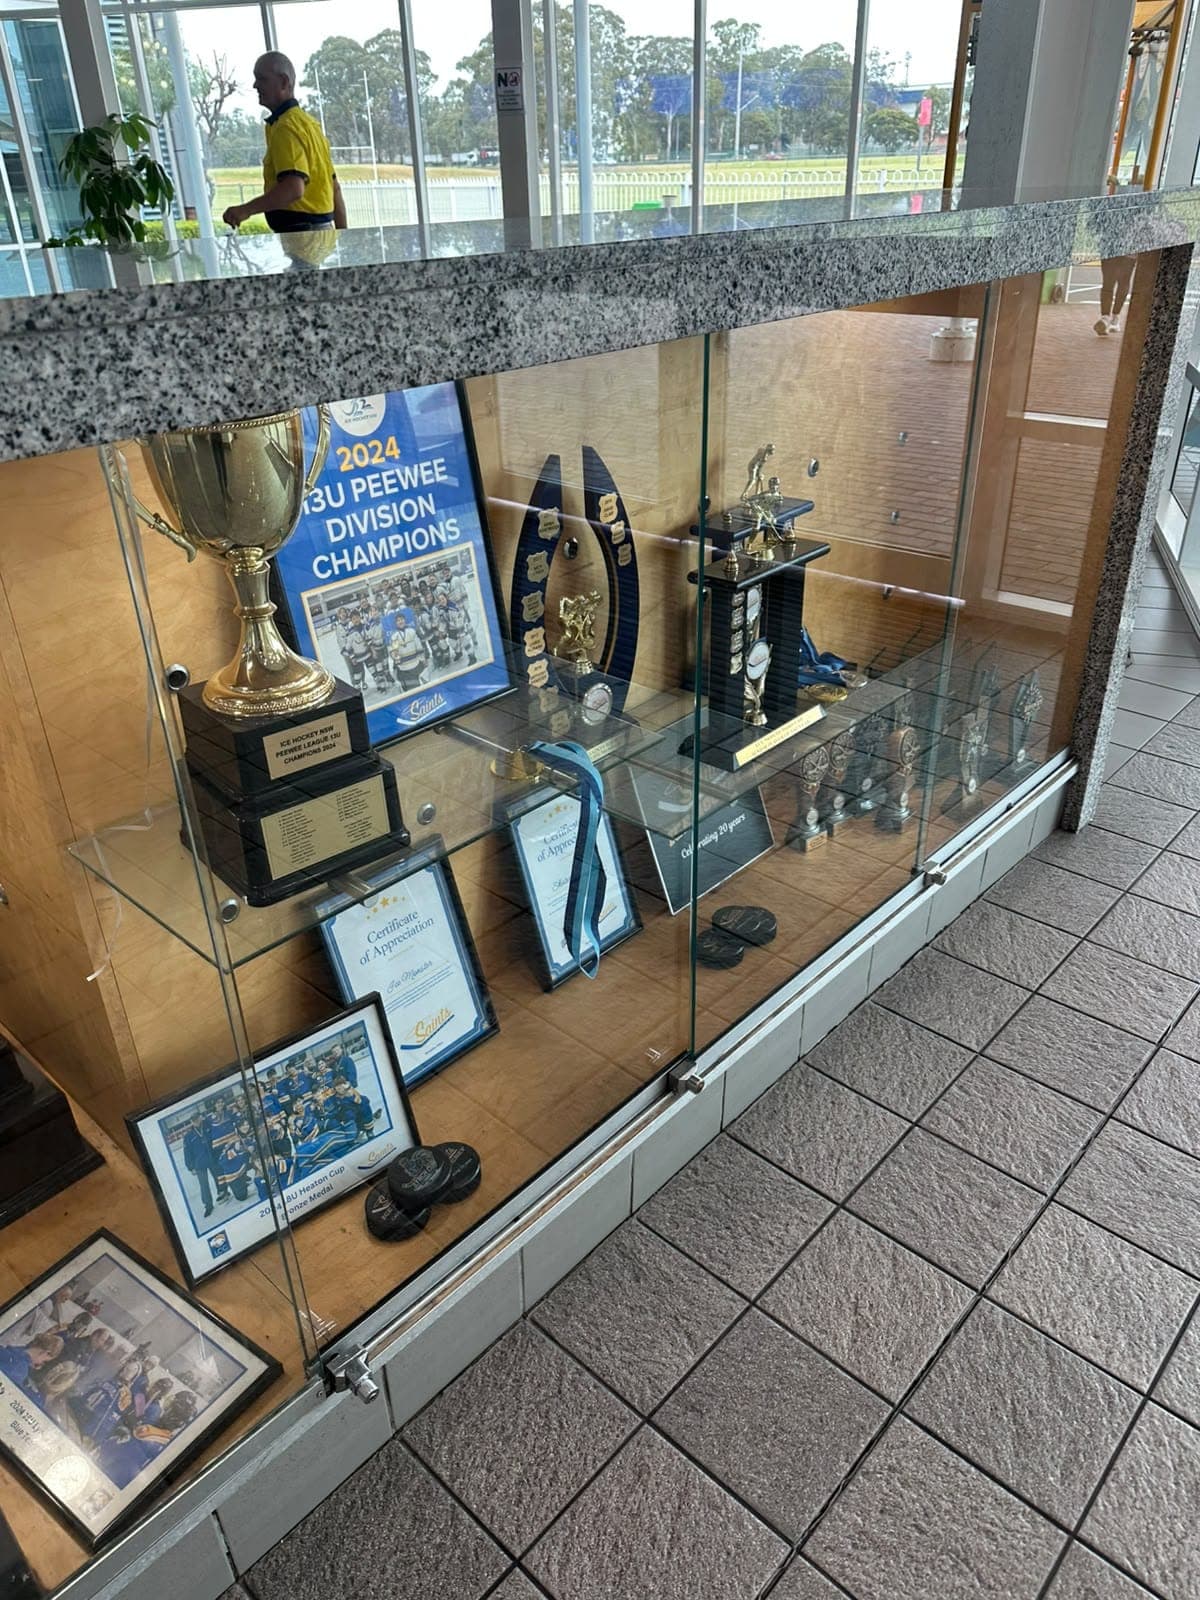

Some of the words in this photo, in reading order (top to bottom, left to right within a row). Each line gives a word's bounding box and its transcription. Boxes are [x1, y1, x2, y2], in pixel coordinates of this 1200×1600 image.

[336, 436, 400, 472] 2024
[350, 458, 449, 502] PEEWEE
[325, 493, 436, 543] DIVISION
[312, 518, 461, 579] CHAMPIONS
[276, 744, 302, 758] PEEWEE
[303, 736, 329, 749] LEAGUE
[280, 739, 291, 748] ICE
[292, 730, 319, 744] HOCKEY
[320, 725, 334, 734] NSW
[283, 747, 321, 764] CHAMPIONS
[718, 823, 728, 835] 20
[728, 813, 746, 833] years
[359, 951, 373, 966] of
[374, 916, 434, 961] Appreciation
[366, 910, 419, 944] Certificate
[414, 1007, 453, 1044] Saints
[300, 1175, 329, 1195] Heaton
[329, 1165, 345, 1178] Cup
[309, 1184, 334, 1202] Medal
